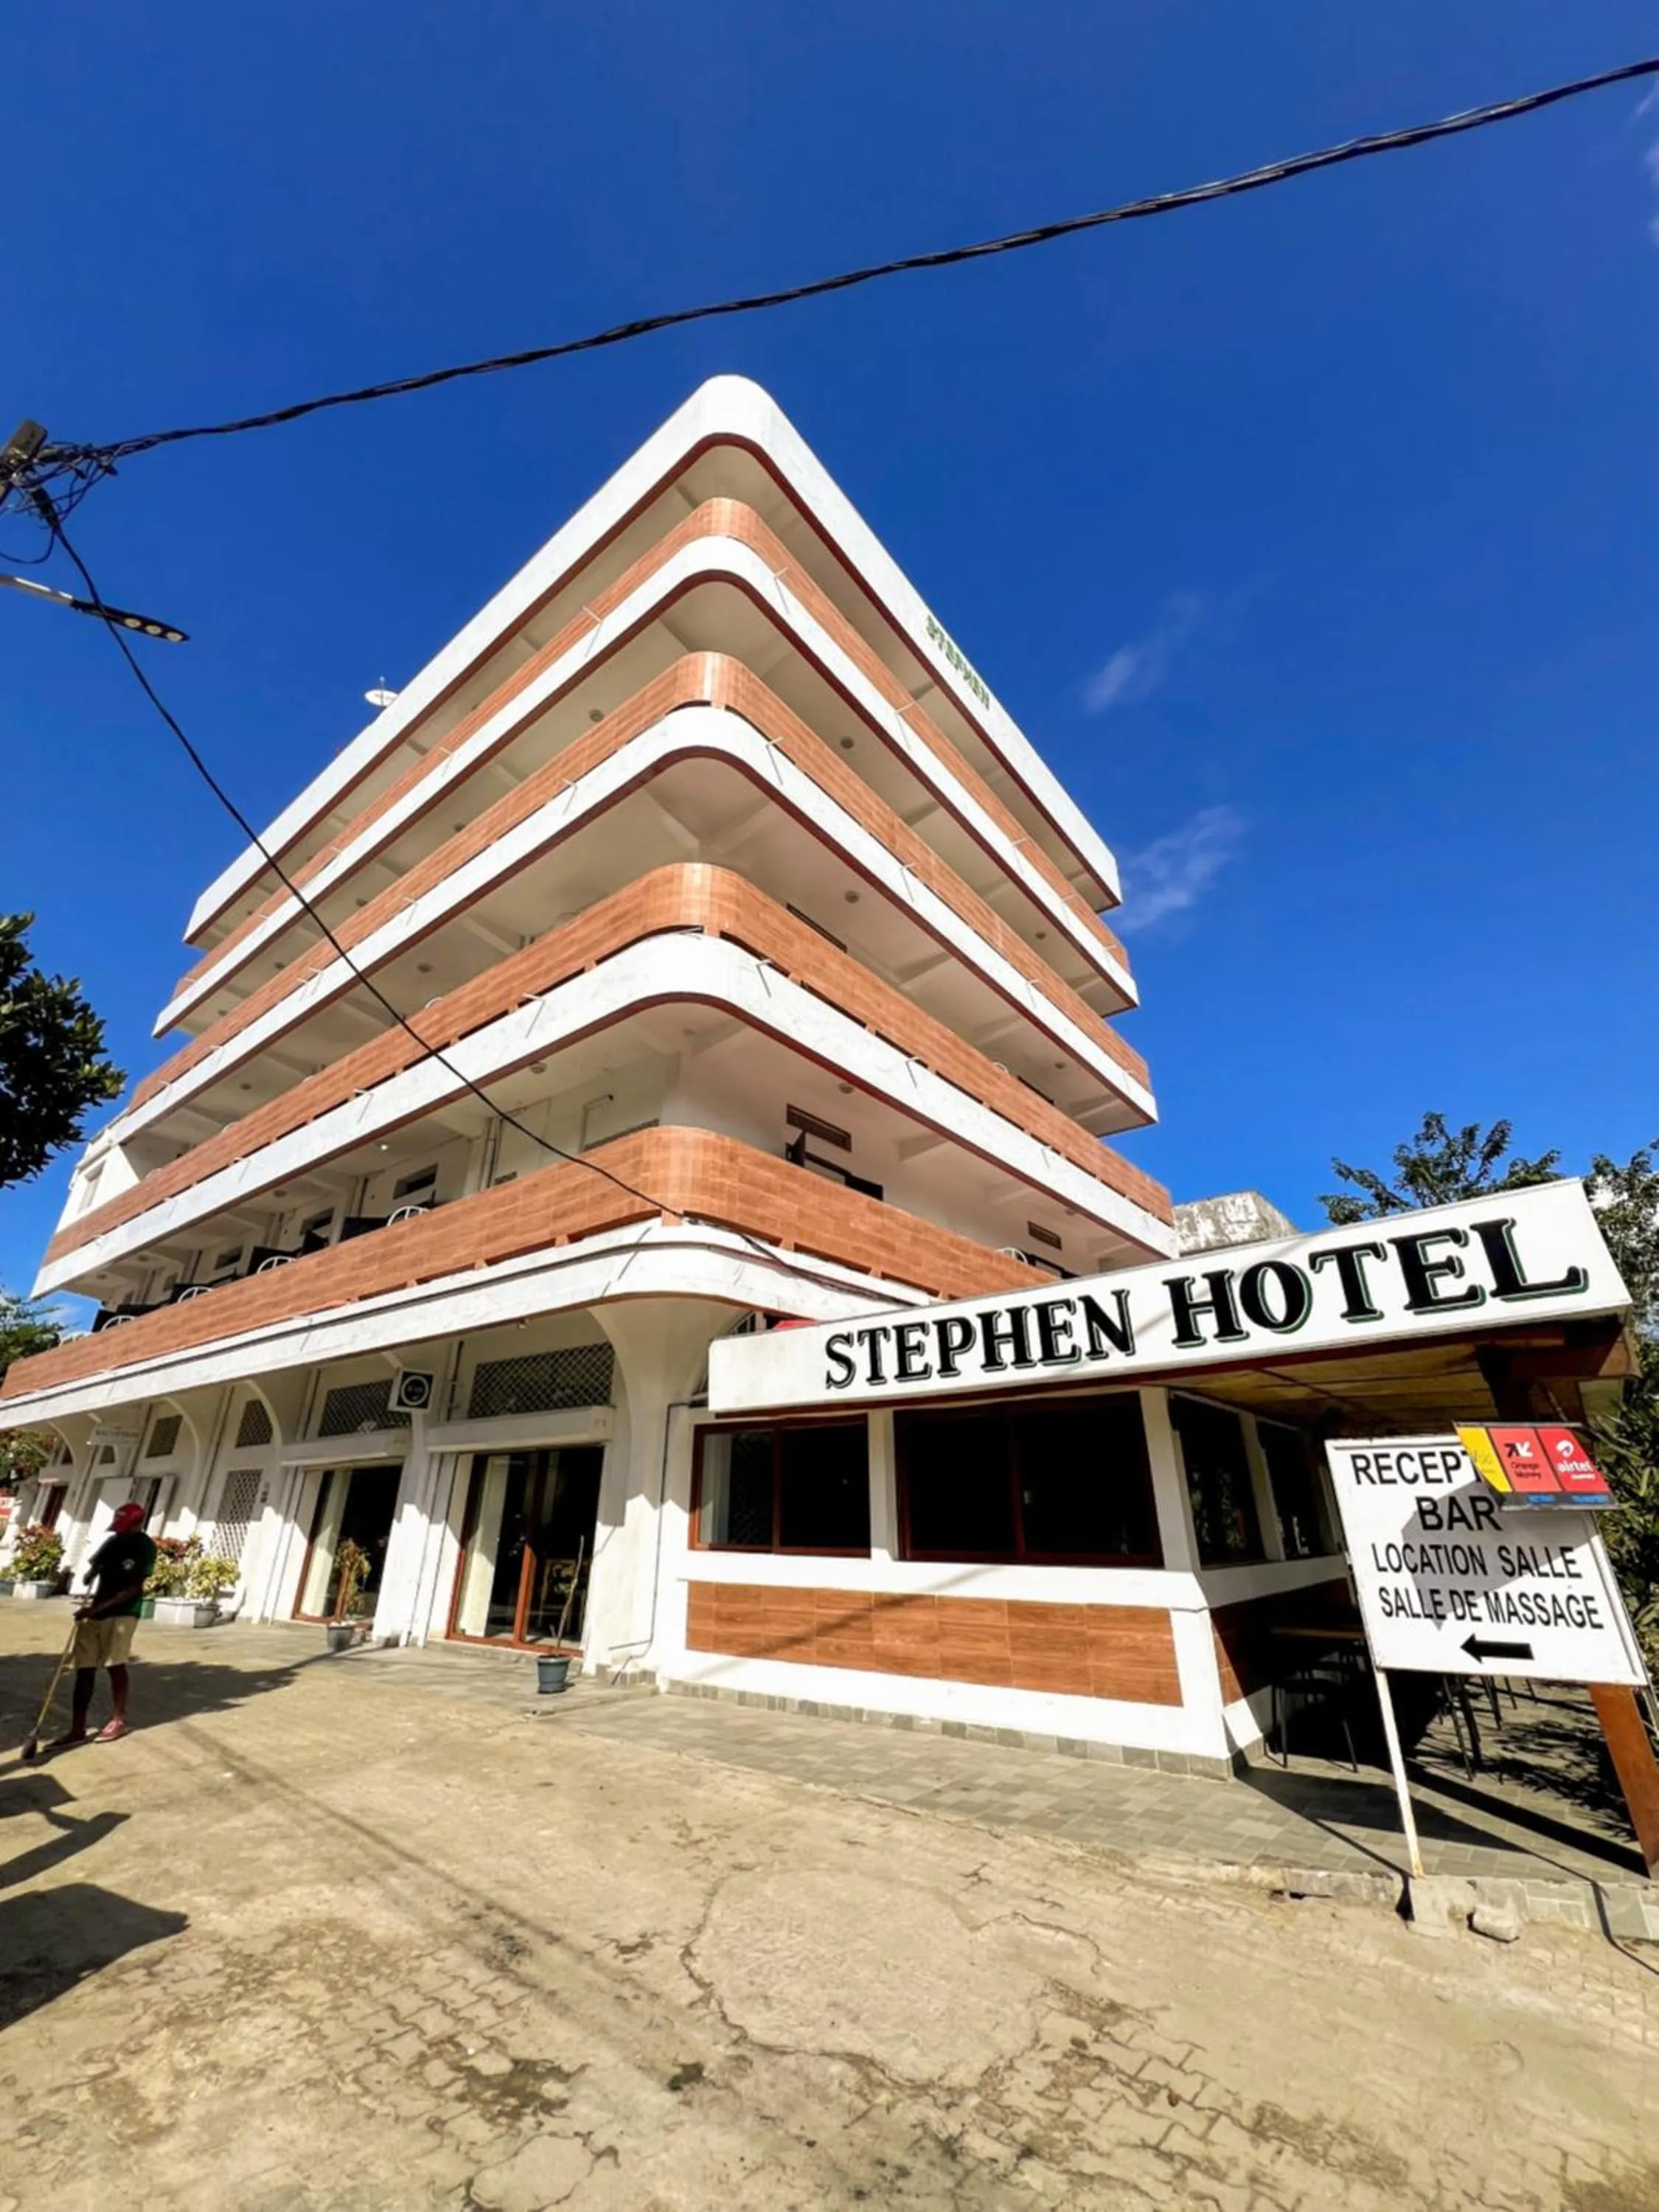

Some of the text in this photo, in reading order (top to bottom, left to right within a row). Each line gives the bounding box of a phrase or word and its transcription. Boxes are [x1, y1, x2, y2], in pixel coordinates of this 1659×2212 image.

[825, 1217, 1589, 1389] STEPHEN HOTEL
[1557, 1460, 1593, 1472] airtel
[1415, 1496, 1503, 1531] BAR
[1371, 1543, 1582, 1579] LOCATION SALLE
[1379, 1587, 1604, 1630] SALLE DE MASSAGE
